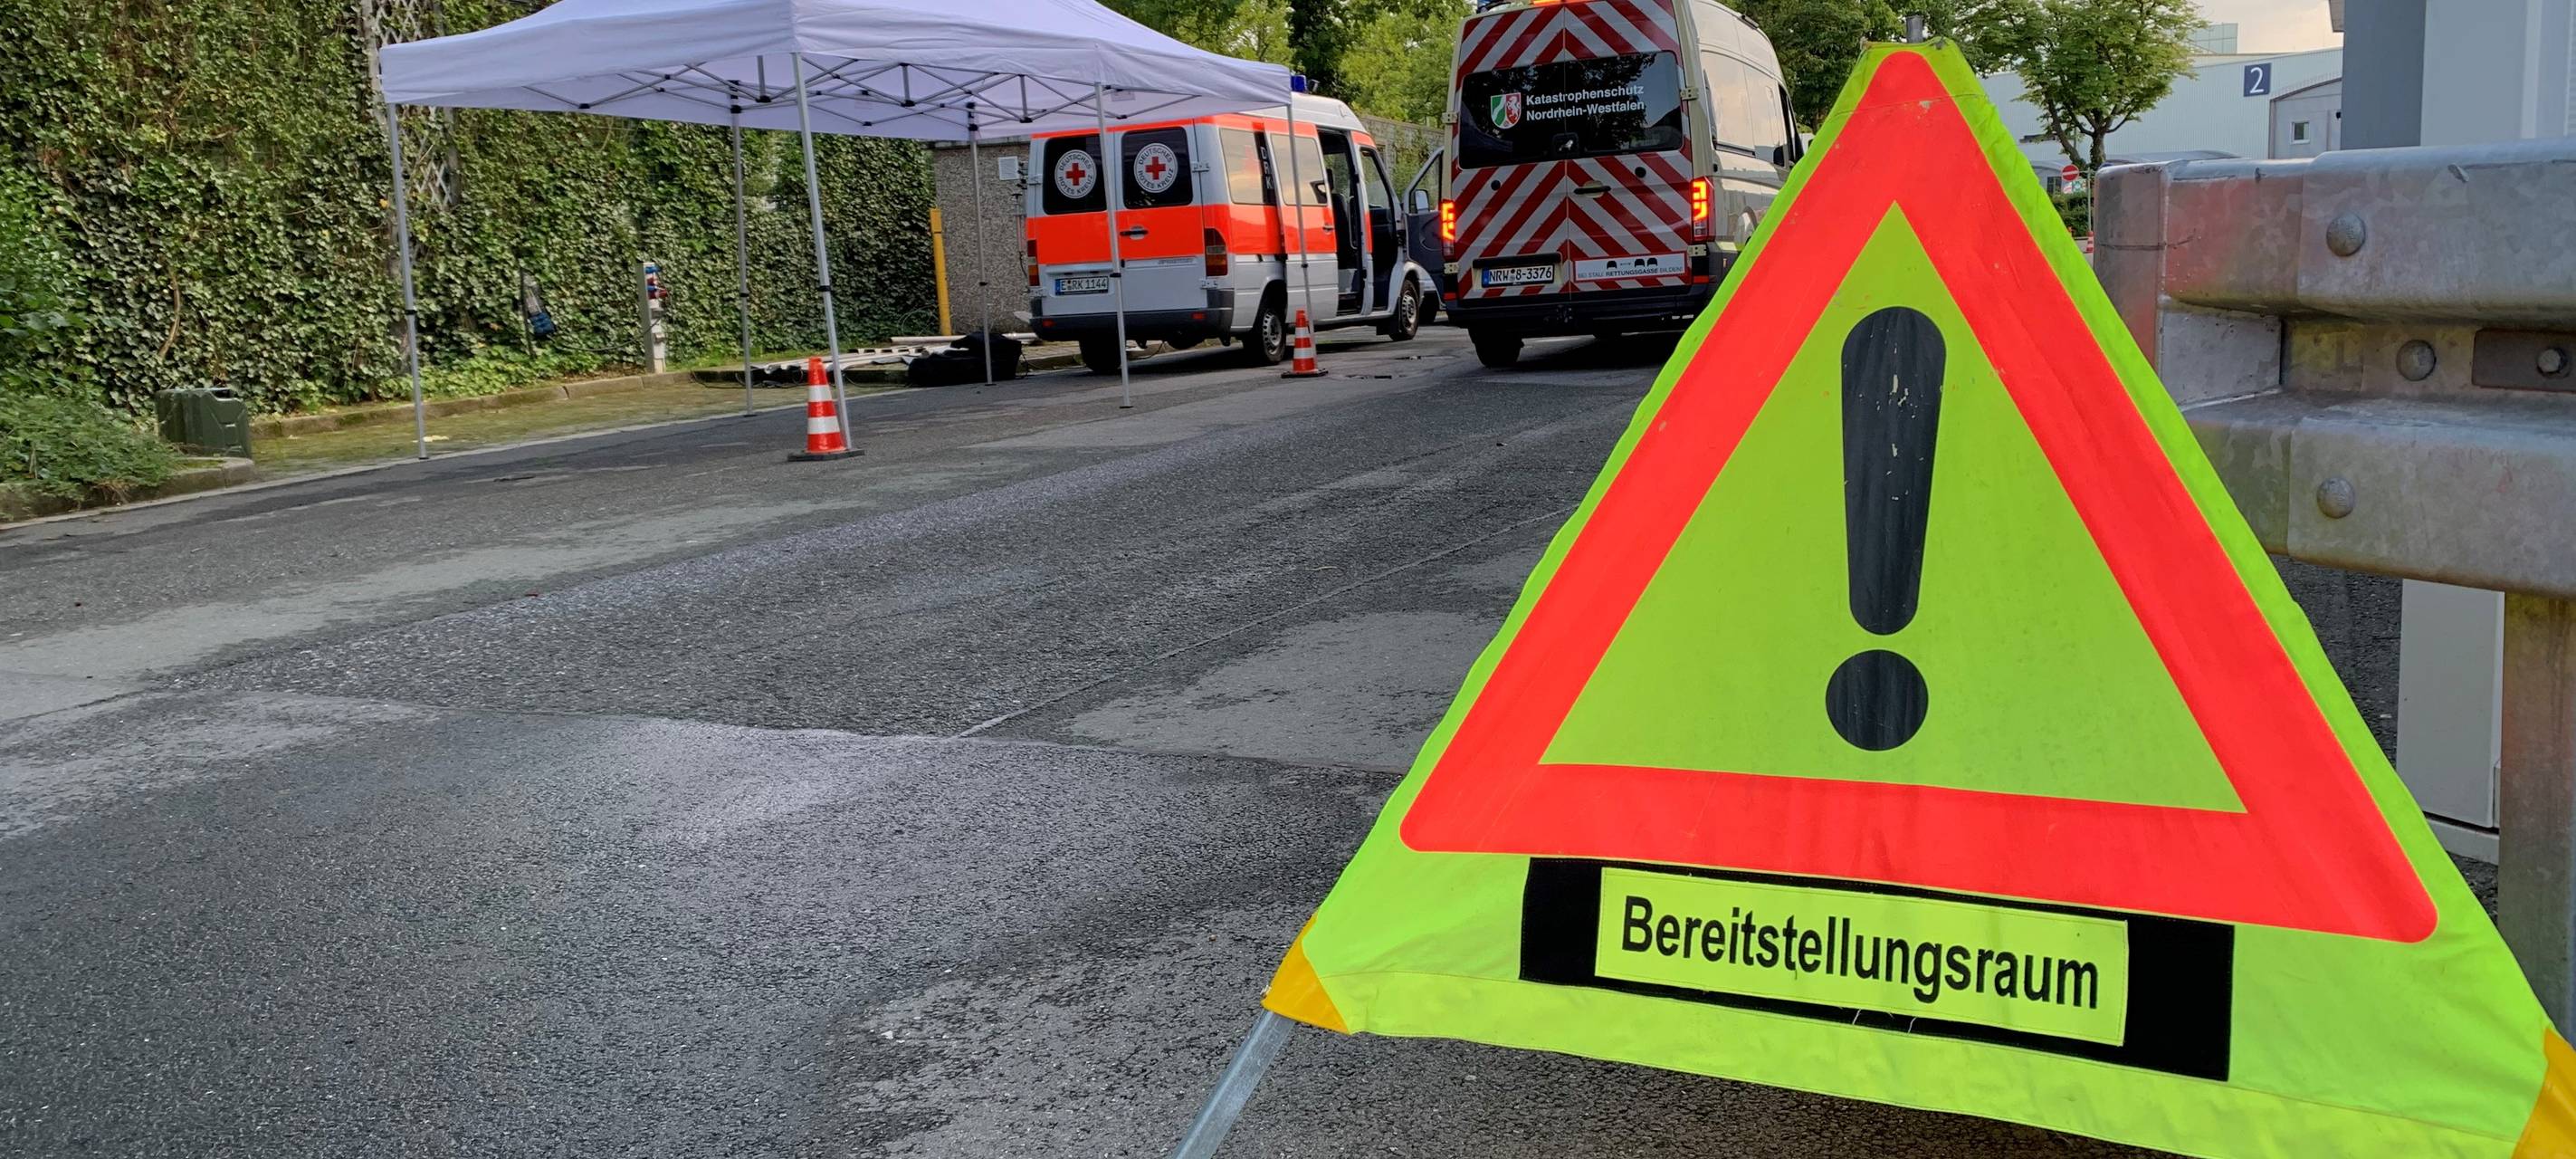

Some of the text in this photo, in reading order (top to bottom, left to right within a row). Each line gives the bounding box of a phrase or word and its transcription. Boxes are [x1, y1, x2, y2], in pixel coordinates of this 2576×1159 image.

[2249, 67, 2264, 93] 2
[1526, 84, 1645, 106] Katastrophenschutz
[1526, 101, 1645, 121] Nordrhein-Westfalen
[1058, 153, 1092, 171] DEUTSCHES
[1138, 147, 1173, 165] DEUTSCHES
[1489, 266, 1552, 283] NRW 8-3376
[1622, 896, 2098, 1010] Bereitstellungsraum
